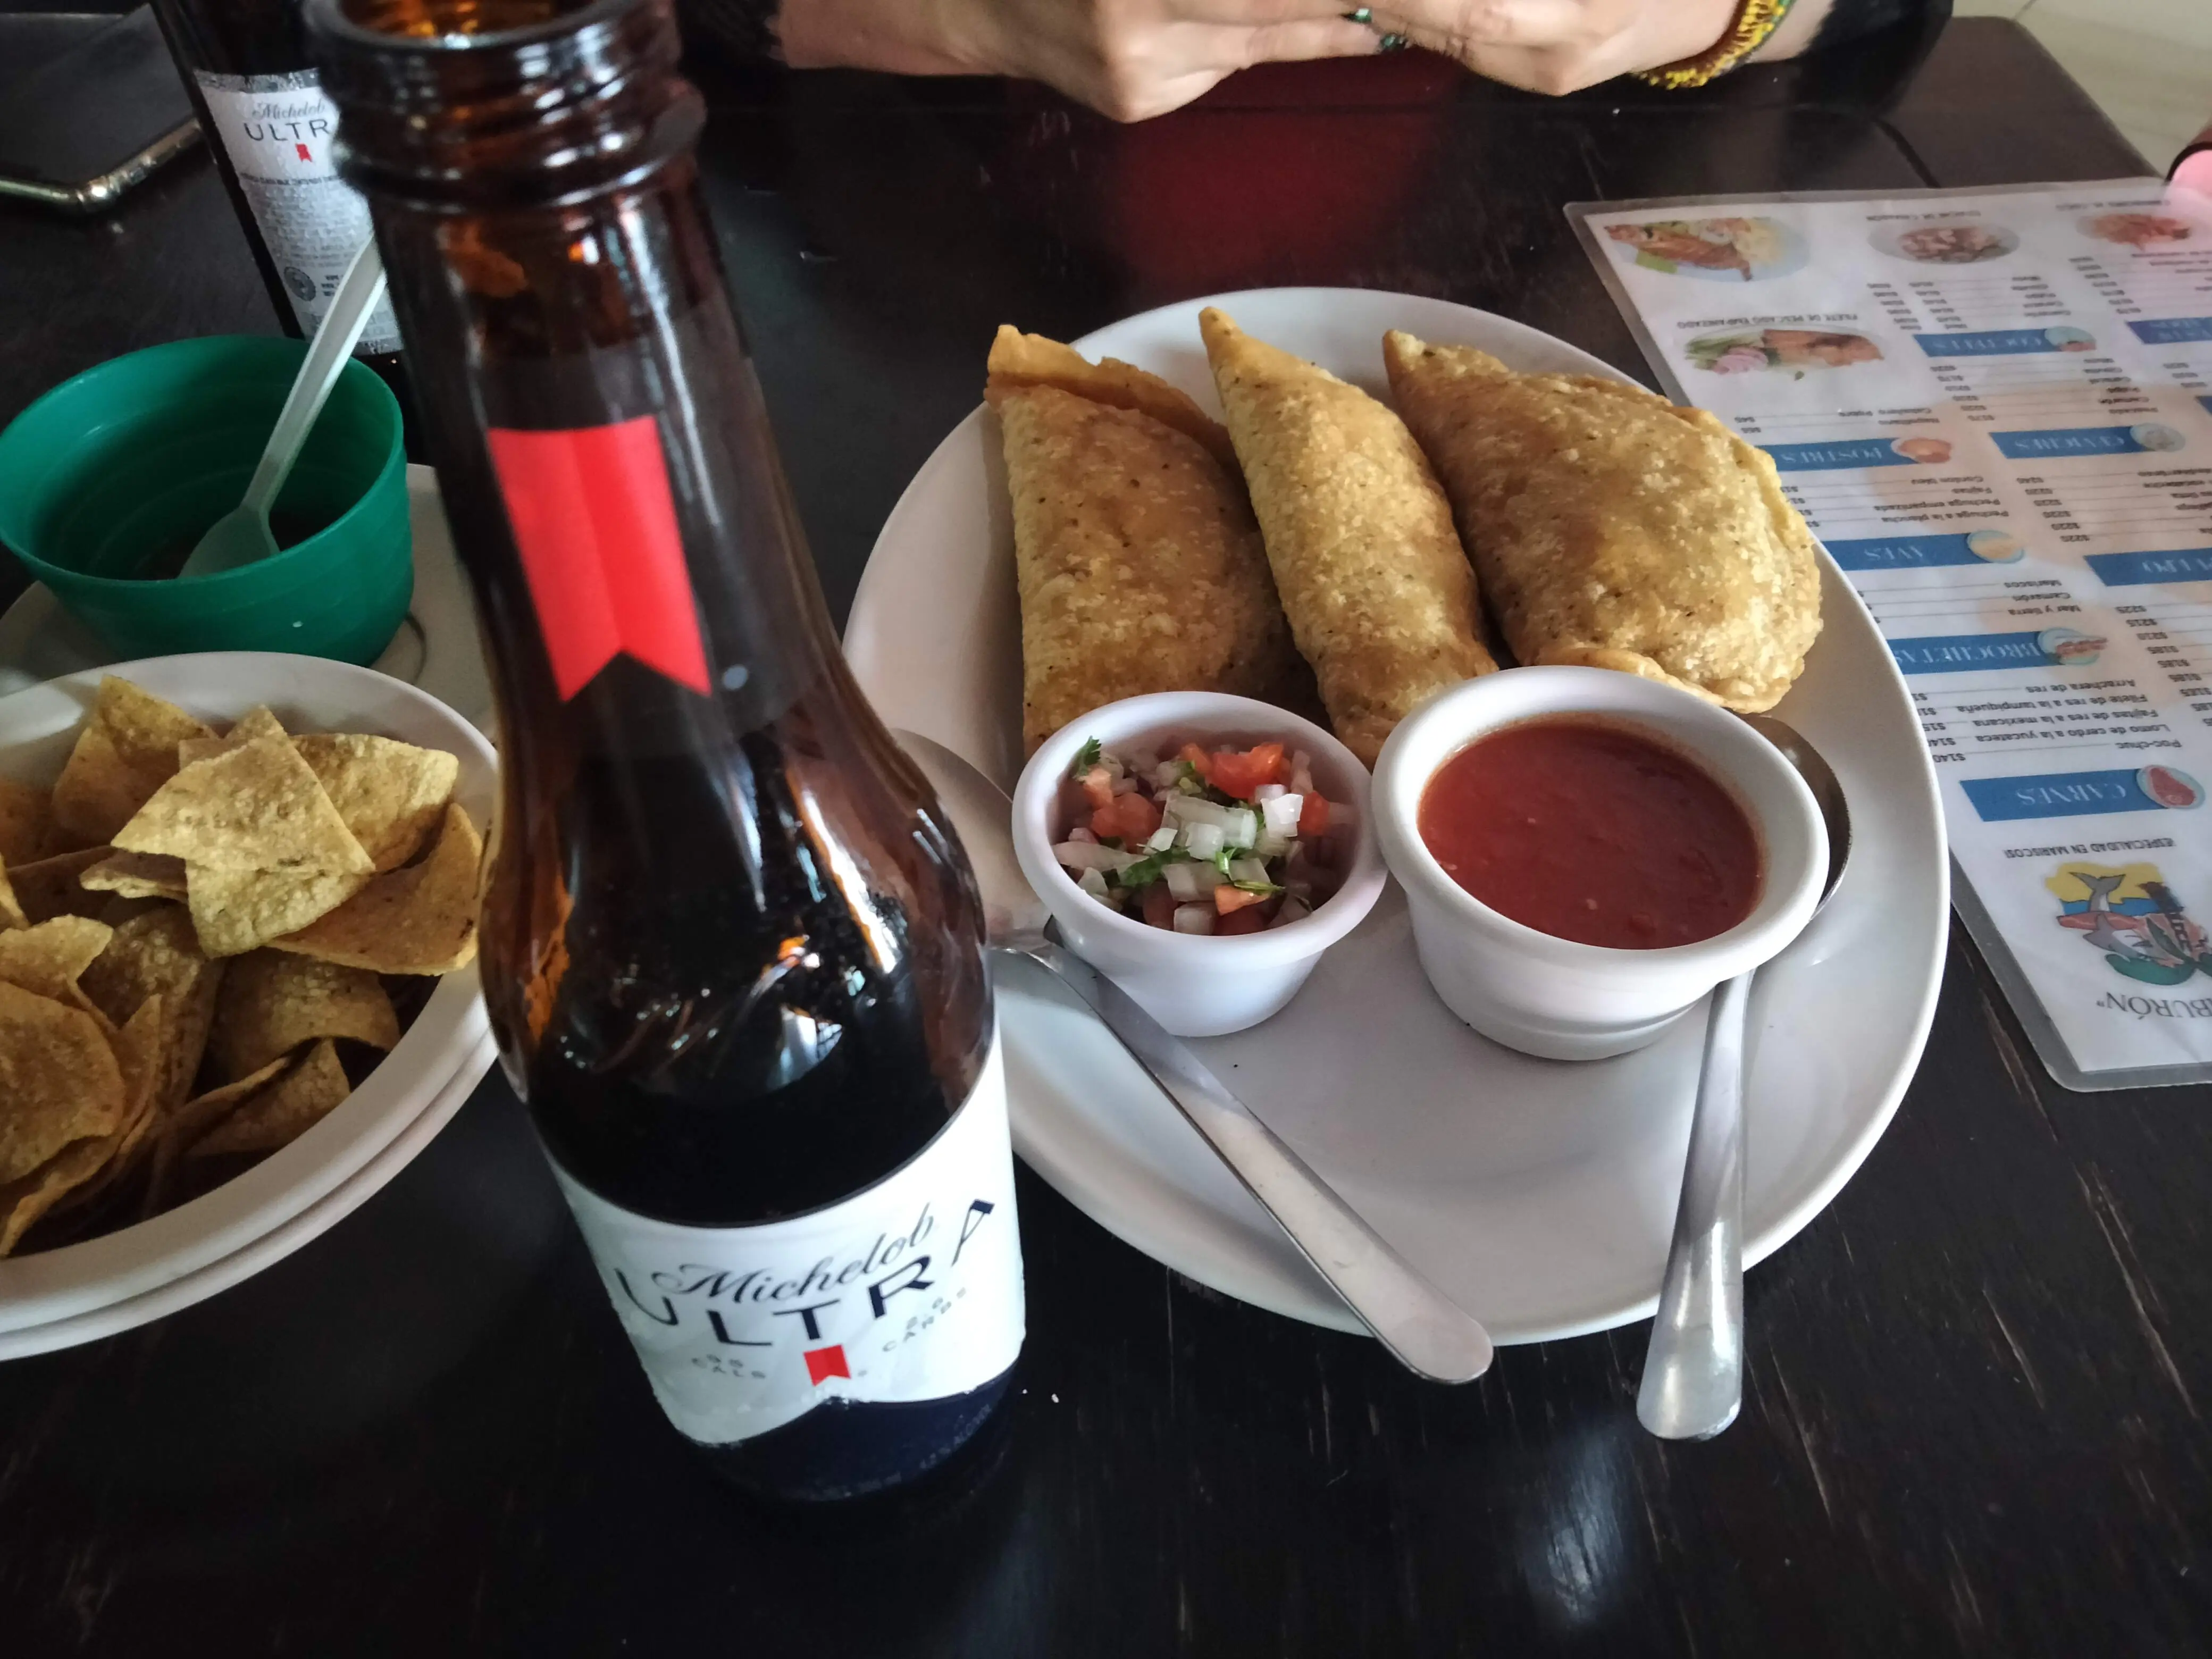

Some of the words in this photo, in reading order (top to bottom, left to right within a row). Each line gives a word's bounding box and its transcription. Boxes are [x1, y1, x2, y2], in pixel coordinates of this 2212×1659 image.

[252, 99, 325, 120] Michelob
[244, 119, 330, 141] ULTR
[1864, 546, 1923, 560] AVES
[1891, 642, 2041, 663] BROCHETAS
[2025, 685, 2047, 694] res
[2050, 684, 2067, 693] de
[2069, 679, 2135, 690] Arrachera
[2089, 697, 2107, 706] de
[2108, 694, 2148, 703] Filete
[1957, 702, 2037, 714] tampiqueña
[2092, 713, 2109, 721] de
[2112, 709, 2158, 719] Fajitas
[1972, 717, 2038, 727] mexicana
[1921, 723, 1946, 732] $15
[2109, 727, 2126, 735] de
[2129, 724, 2170, 732] Lomo
[1974, 730, 2038, 743] yucateca
[2040, 731, 2055, 740] la
[2067, 728, 2106, 738] cerdo
[2115, 739, 2182, 750] Poc-chuc
[1931, 752, 1966, 763] $140
[2016, 783, 2127, 806] CARNES
[2070, 844, 2087, 854] EN
[2096, 992, 2212, 1020] BURÓN"
[651, 1201, 934, 1304] Michelob
[615, 1198, 995, 1347] ULTRA
